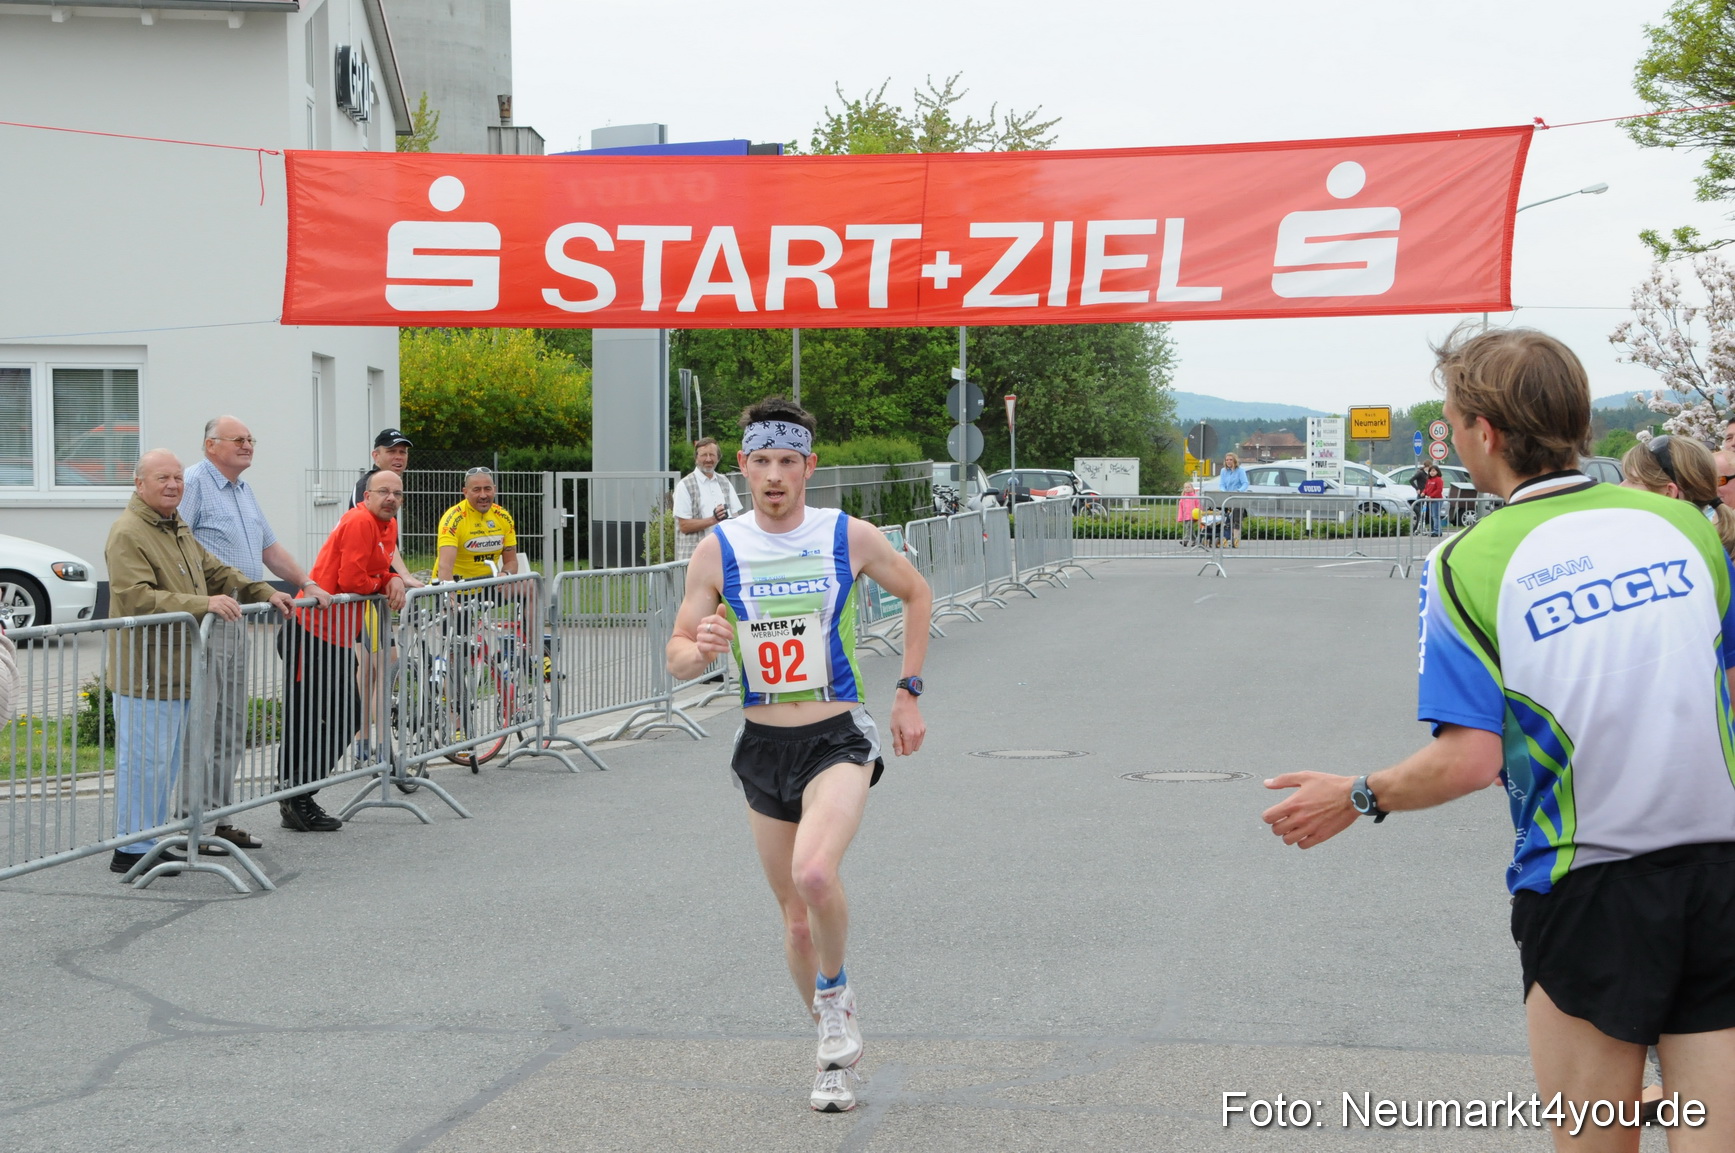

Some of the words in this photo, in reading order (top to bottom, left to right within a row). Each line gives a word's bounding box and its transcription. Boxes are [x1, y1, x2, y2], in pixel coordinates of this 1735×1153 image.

[349, 46, 375, 123] GRAF
[1354, 418, 1387, 427] Neumarkt
[1434, 426, 1444, 436] 60
[466, 540, 501, 548] Mercatone
[1517, 555, 1594, 591] TEAM
[750, 577, 831, 597] BOCK
[1524, 559, 1694, 642] BOCK
[751, 619, 789, 632] MEYER
[752, 629, 790, 639] WERBUNG
[758, 639, 808, 685] 92
